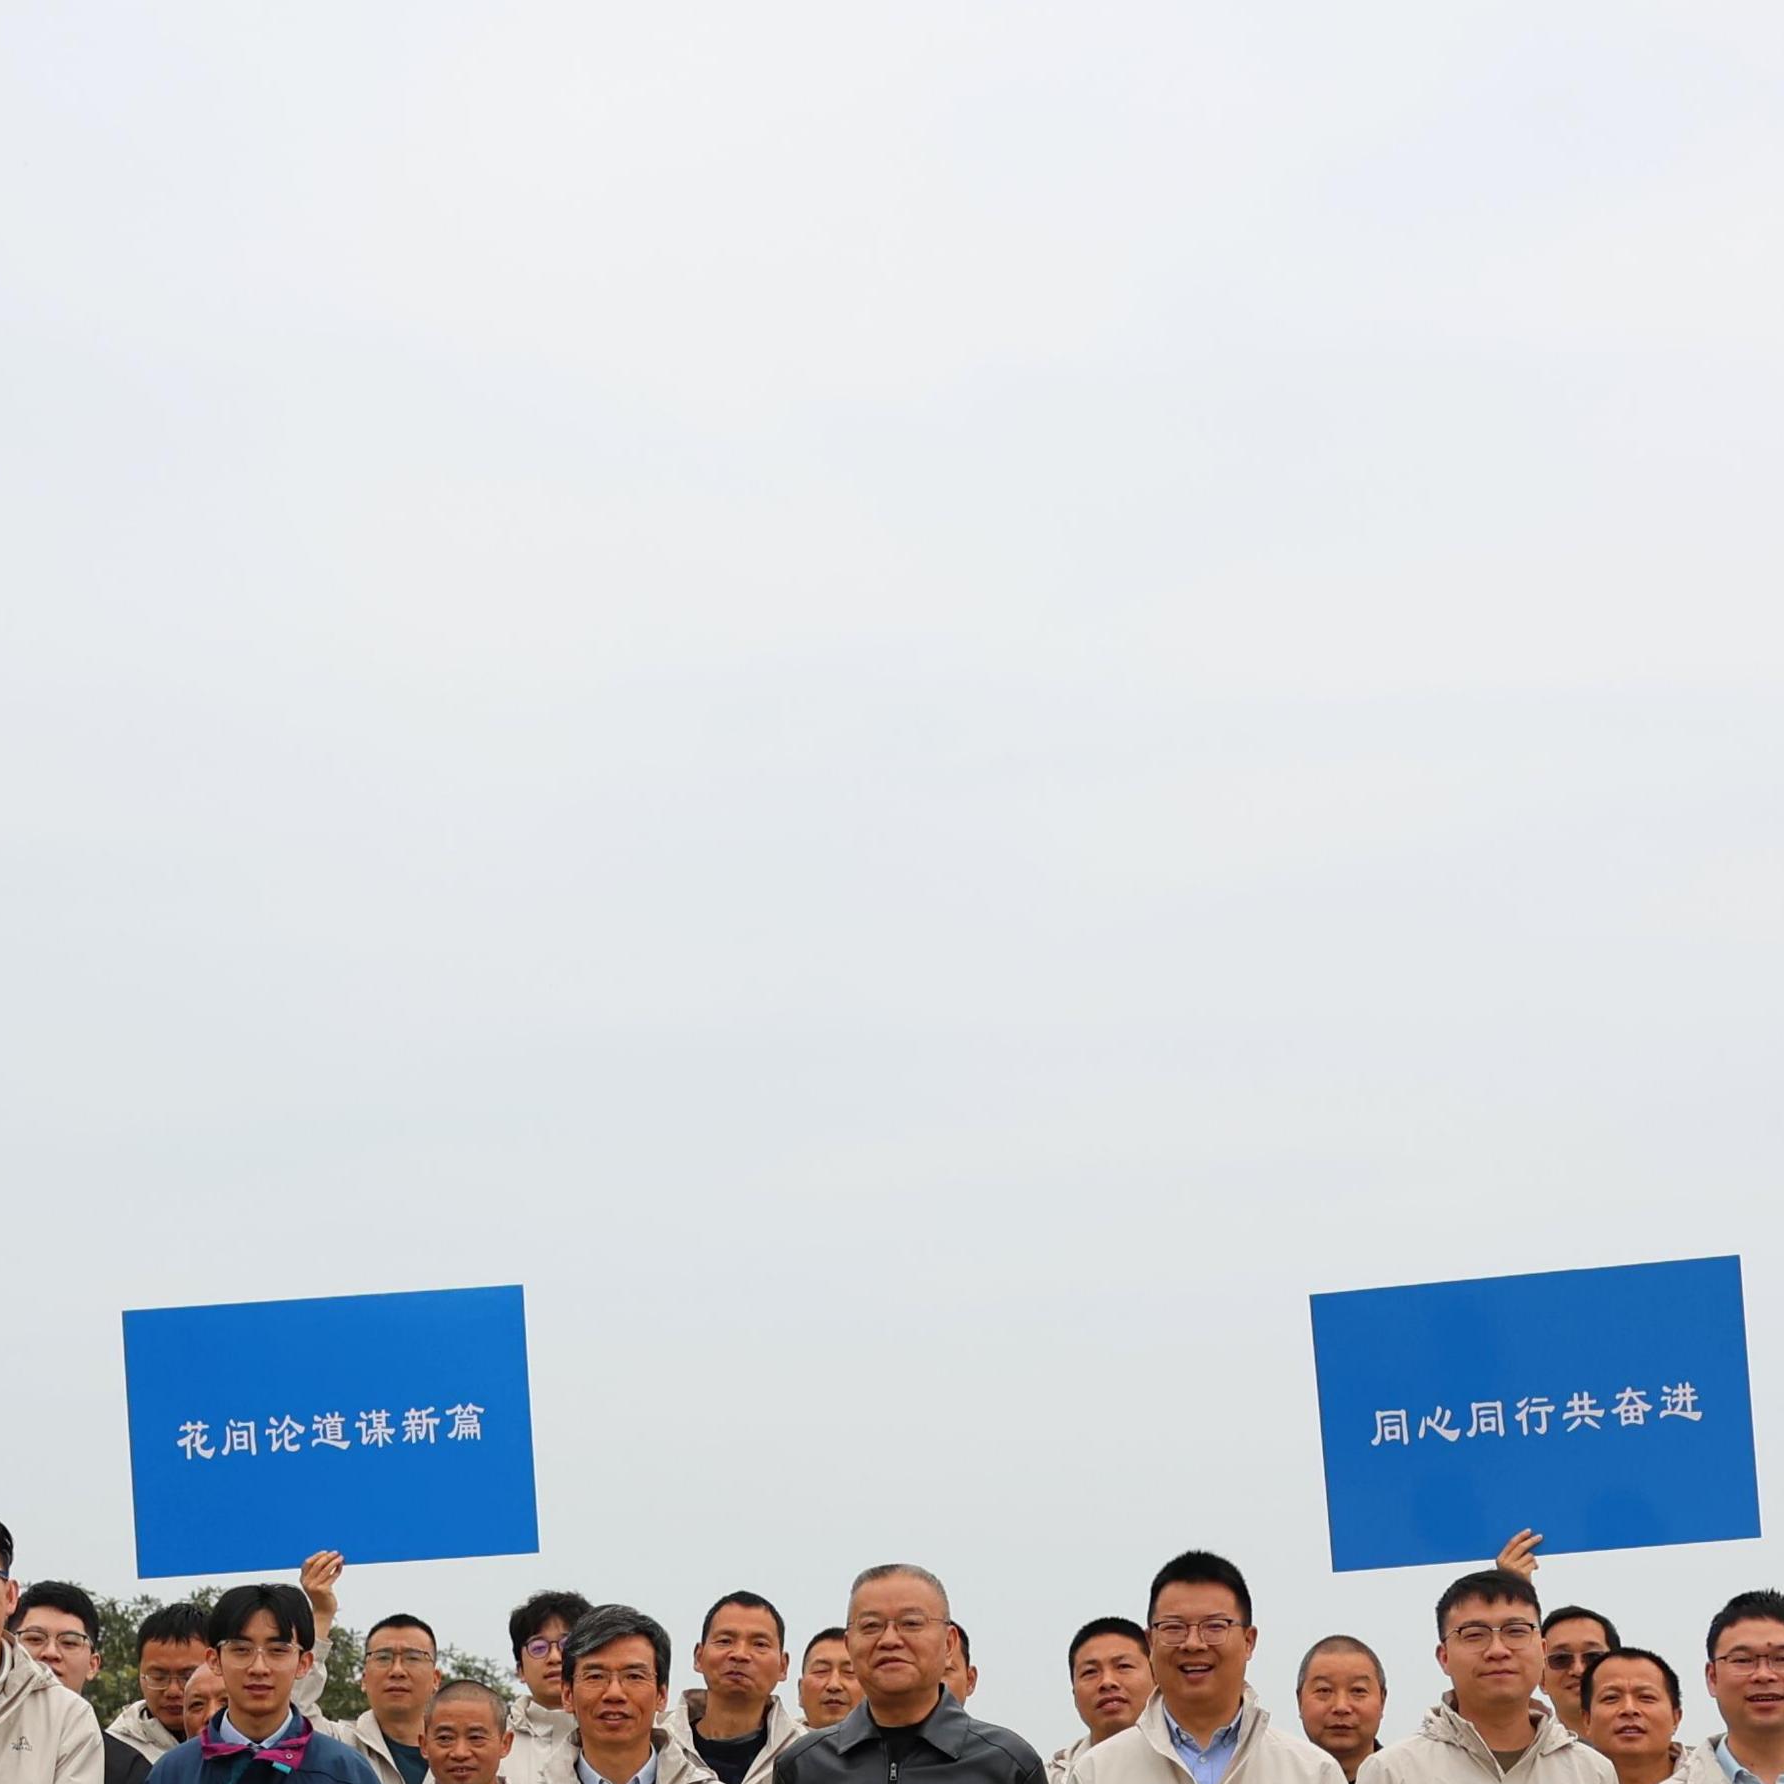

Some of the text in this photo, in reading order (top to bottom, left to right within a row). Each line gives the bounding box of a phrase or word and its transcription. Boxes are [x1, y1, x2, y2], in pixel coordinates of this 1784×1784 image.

[177, 1402, 485, 1460] 花间论道谋新篇
[1371, 1381, 1703, 1446] 同心同行共奋进
